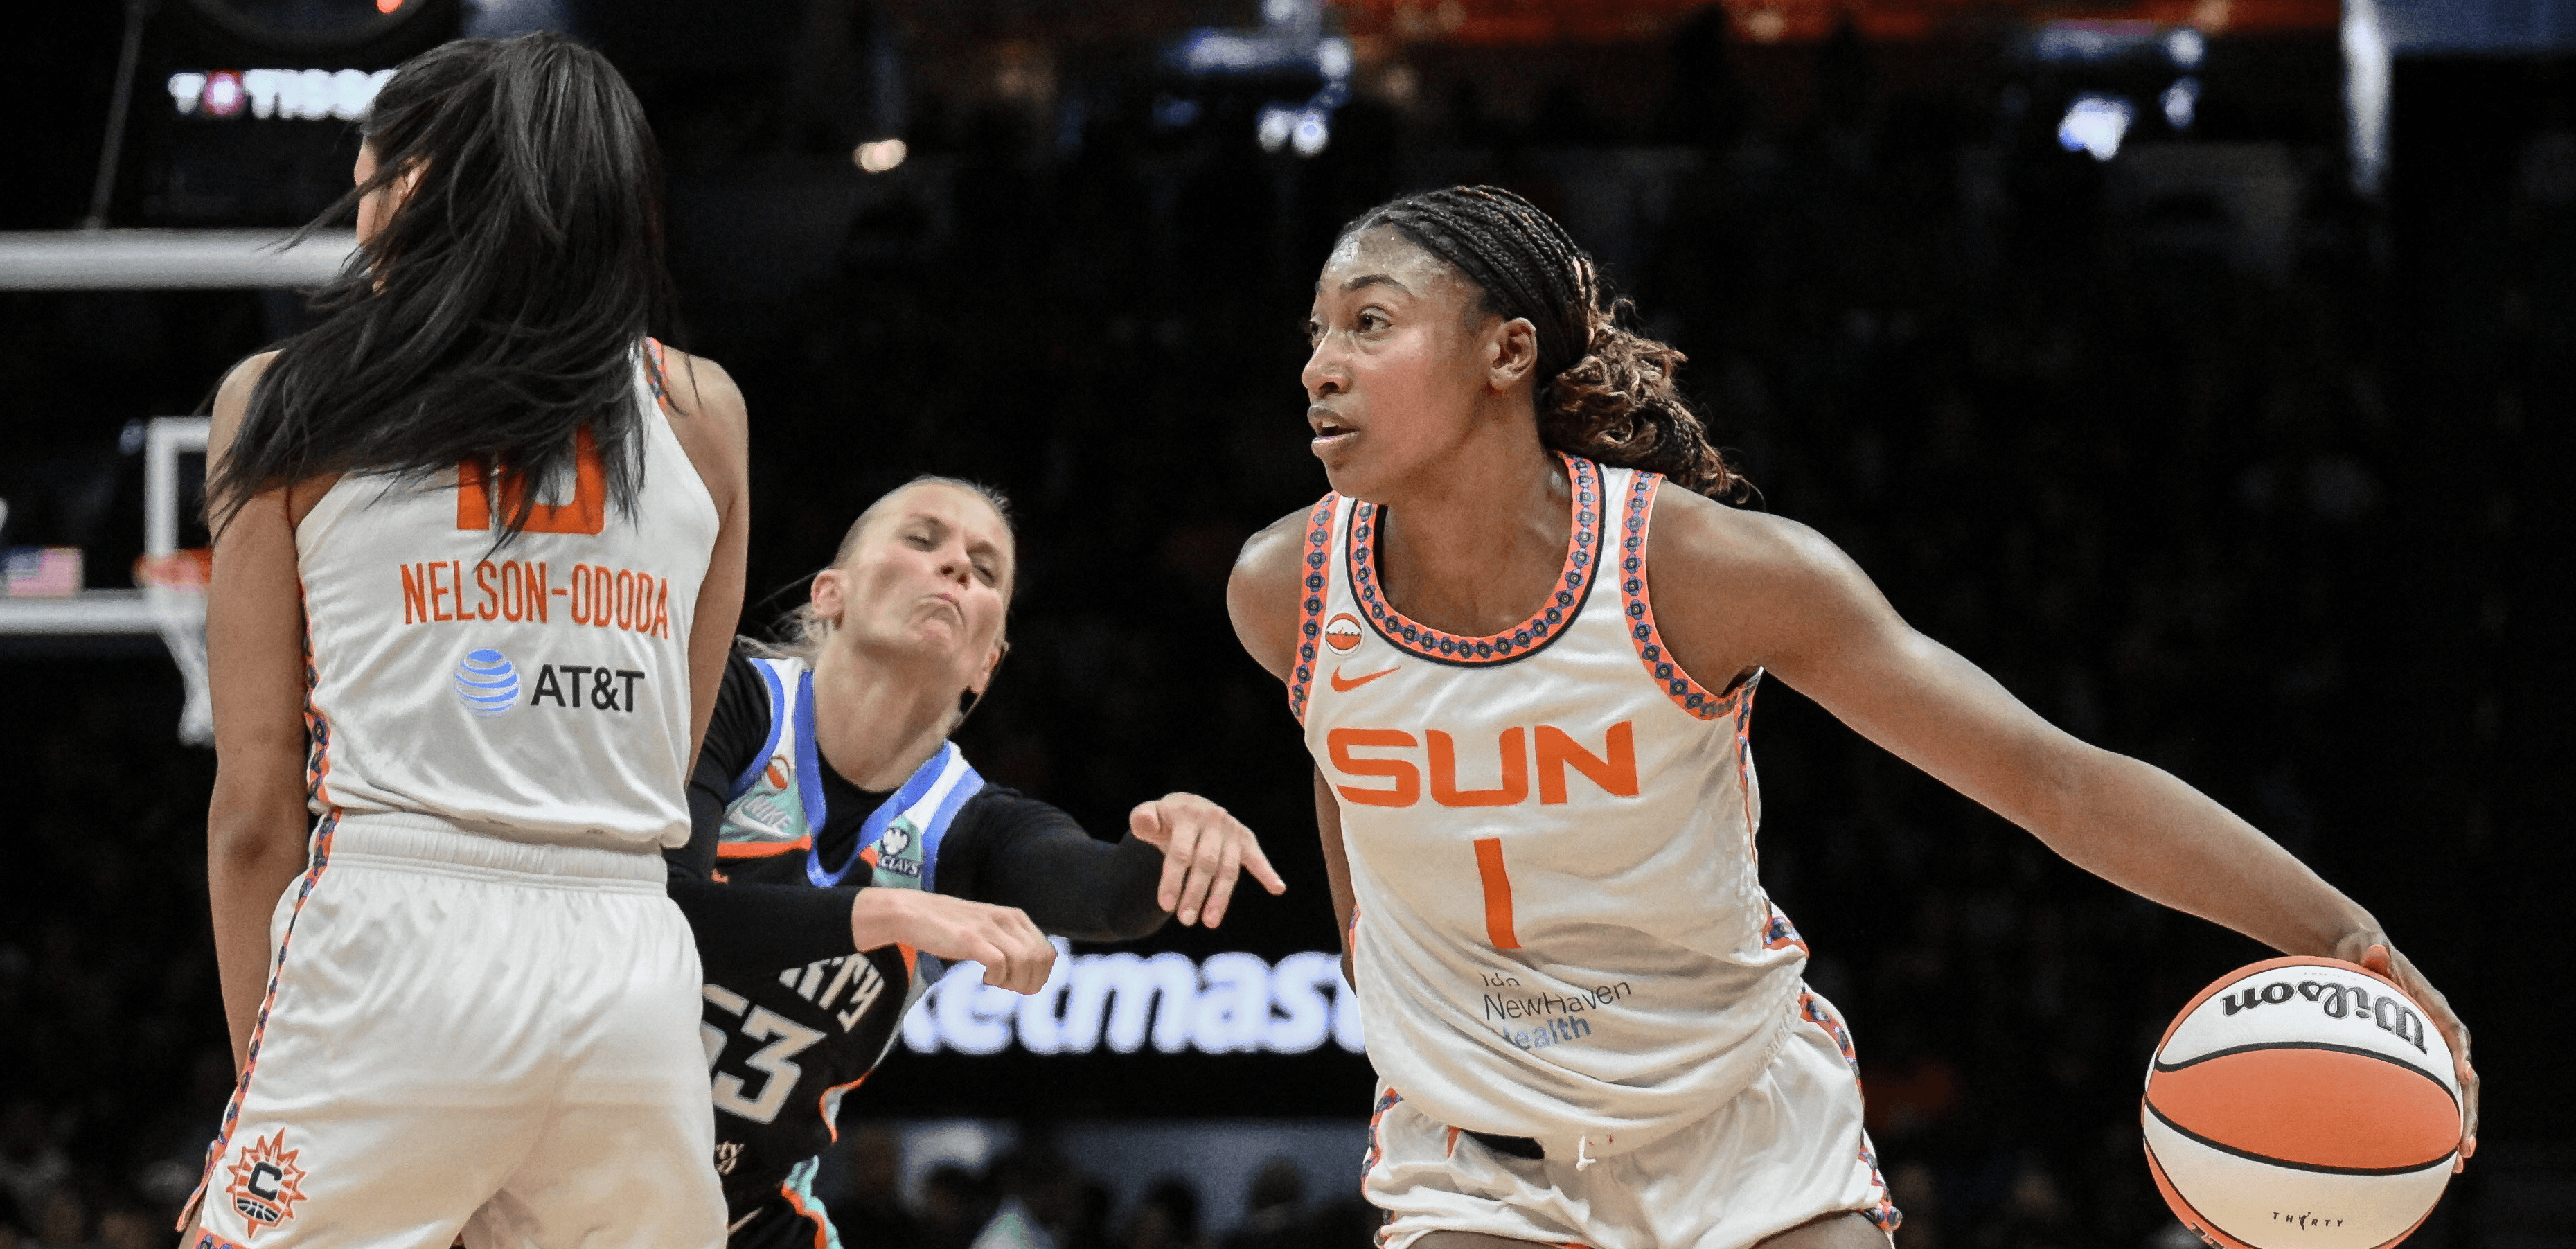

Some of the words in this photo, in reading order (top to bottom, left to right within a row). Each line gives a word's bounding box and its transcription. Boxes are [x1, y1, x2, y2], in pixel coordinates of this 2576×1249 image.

[400, 560, 668, 639] NELSON-ODODA
[531, 664, 645, 712] AT&T
[1327, 720, 1639, 808] SUN
[878, 854, 921, 875] CLAYS
[1473, 838, 1522, 949] 1
[1484, 982, 1632, 1021] NewHaven
[2219, 980, 2428, 1056] Wilson
